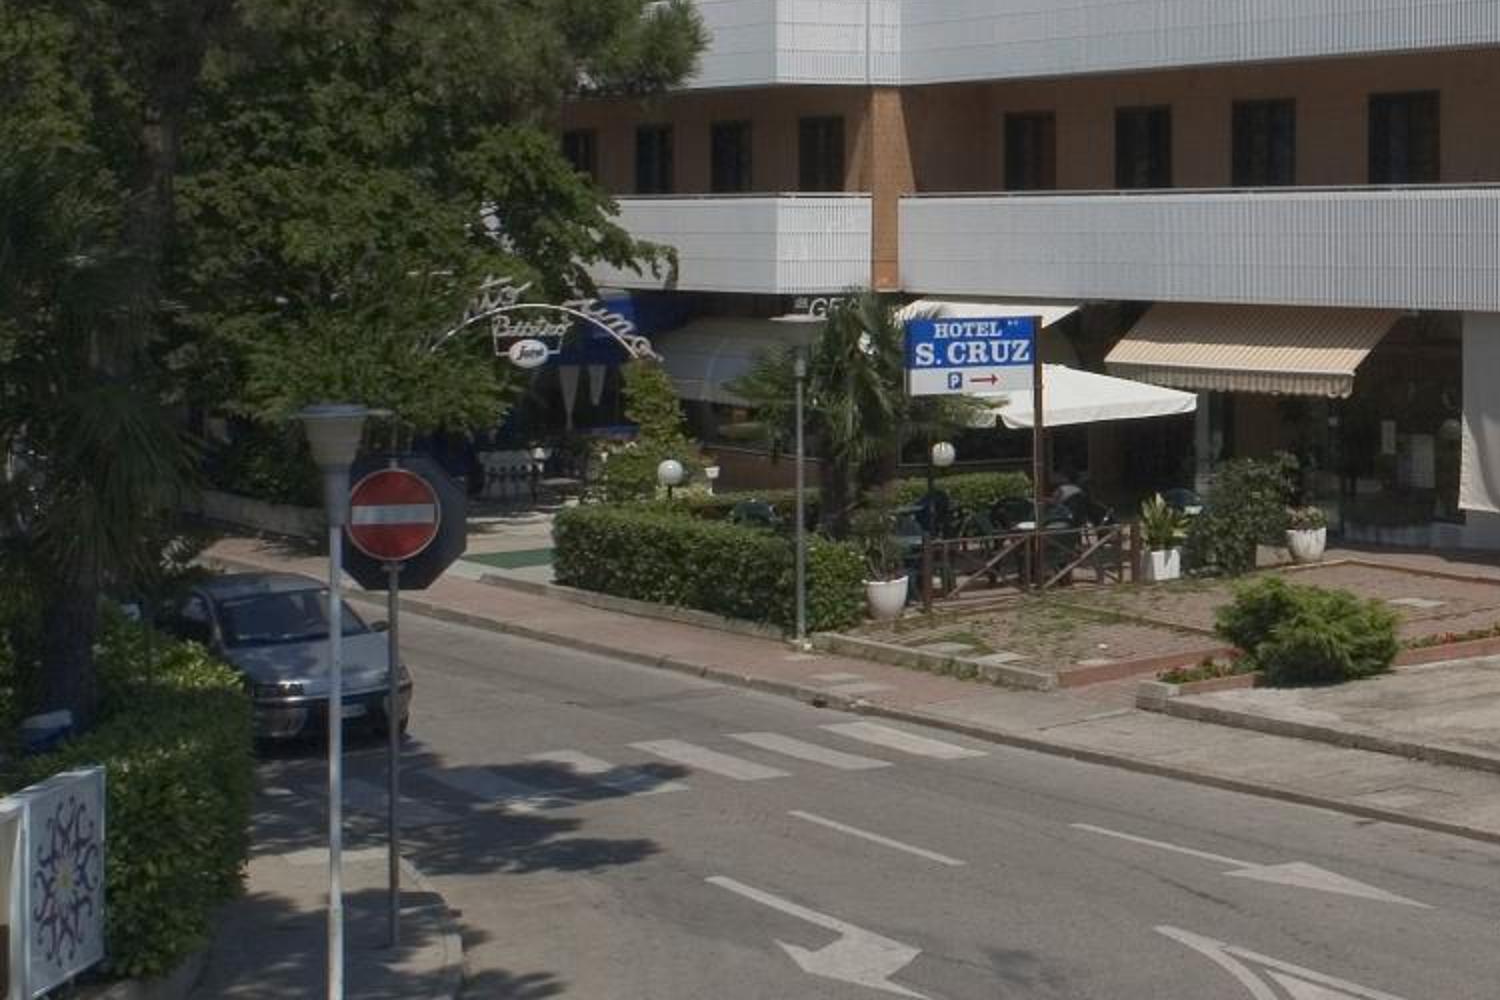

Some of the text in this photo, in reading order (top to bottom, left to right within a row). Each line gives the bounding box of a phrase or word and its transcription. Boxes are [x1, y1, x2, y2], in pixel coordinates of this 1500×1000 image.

[933, 321, 1003, 339] HOTEL
[915, 339, 1031, 366] S. CRUZ
